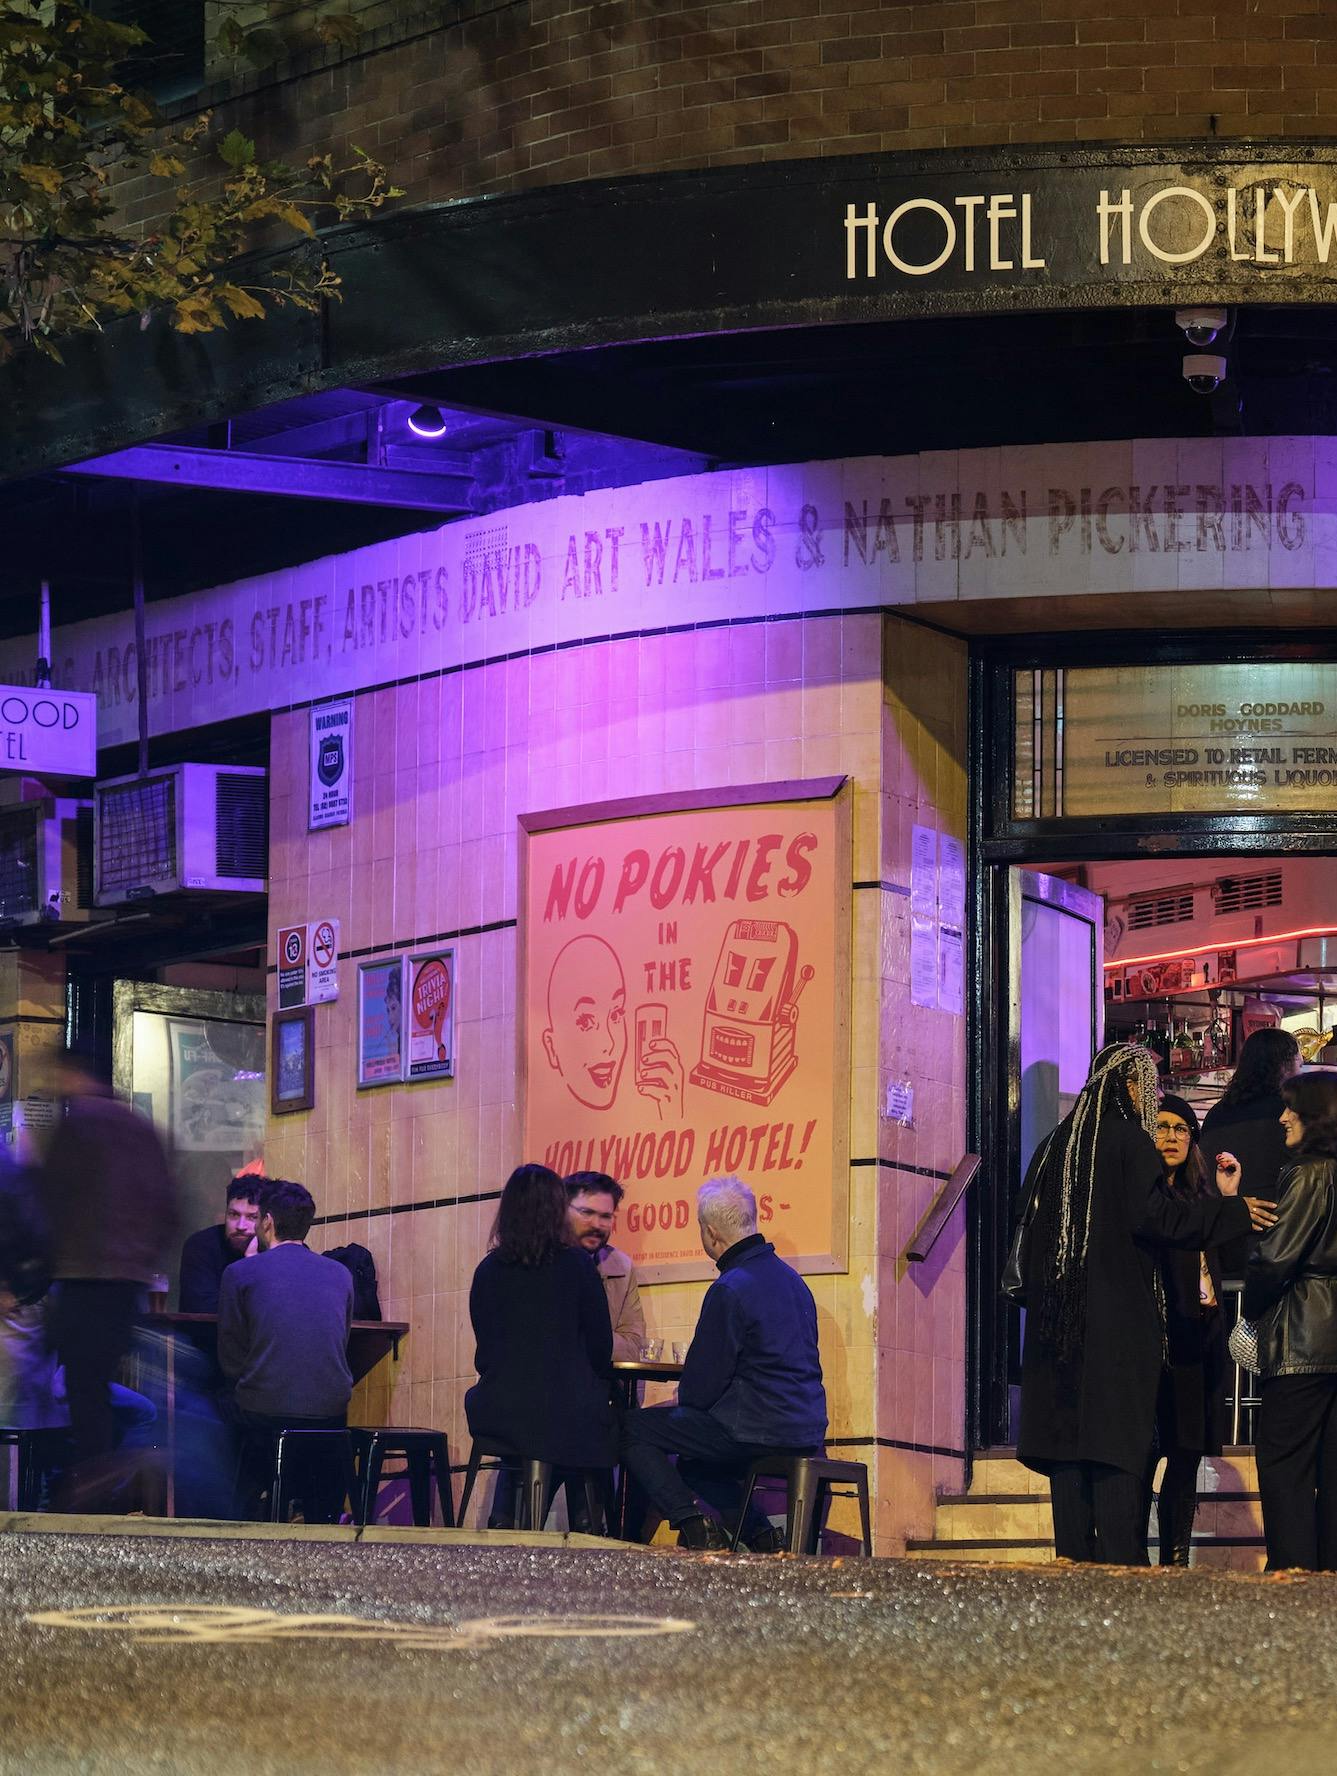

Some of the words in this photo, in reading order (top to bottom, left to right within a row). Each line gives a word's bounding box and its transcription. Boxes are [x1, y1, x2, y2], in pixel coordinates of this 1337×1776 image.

[843, 192, 1046, 279] HOTEL
[342, 566, 448, 654] ARTISTS
[460, 543, 542, 624] DAVID
[561, 526, 625, 601] ART
[639, 507, 776, 587] WALES
[795, 503, 825, 572] &
[844, 489, 1027, 568] NATHAN
[1047, 481, 1306, 555] PICKERING
[315, 711, 349, 731] WARNING
[1177, 702, 1227, 719] DORIS
[1240, 701, 1325, 718] GODDARD
[1209, 717, 1283, 733] HOYNES
[0, 731, 28, 761] EL
[325, 752, 337, 764] MPS
[1104, 748, 1198, 768] LICENSED
[1204, 748, 1226, 765] TO
[1229, 747, 1287, 765] RETAIL
[544, 855, 605, 923] NO
[612, 831, 818, 915] POKIES
[658, 921, 678, 946] IN
[418, 973, 446, 999] TRIVIA
[643, 958, 692, 993] THE
[720, 1085, 753, 1100] KILLER
[544, 1128, 695, 1182] HOLLYWOOD
[703, 1119, 817, 1178] HOTEL!
[626, 1199, 690, 1233] GOOD
